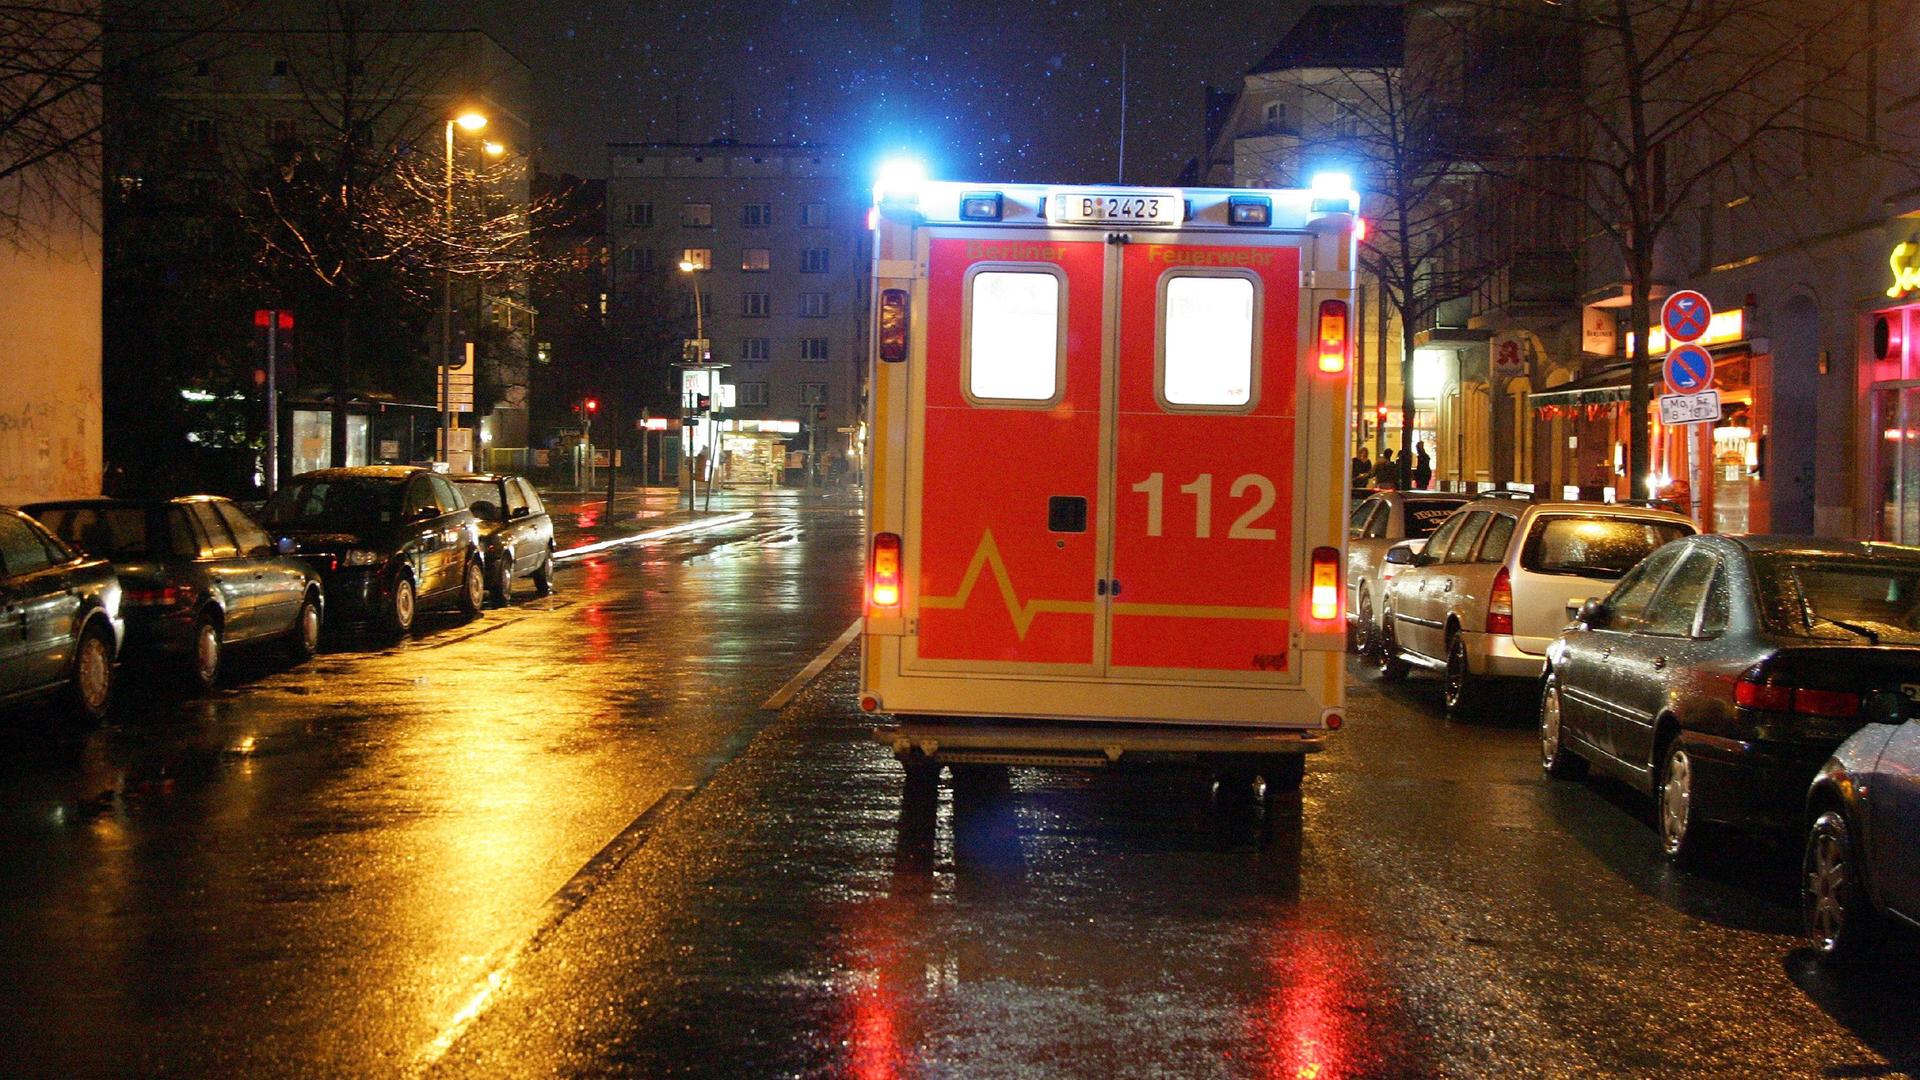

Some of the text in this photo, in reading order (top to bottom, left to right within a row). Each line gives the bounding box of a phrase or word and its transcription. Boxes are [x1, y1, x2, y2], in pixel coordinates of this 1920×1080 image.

[1082, 198, 1159, 218] B 2423
[967, 241, 1274, 265] Berliner Feuerwehr
[1131, 472, 1277, 540] 112
